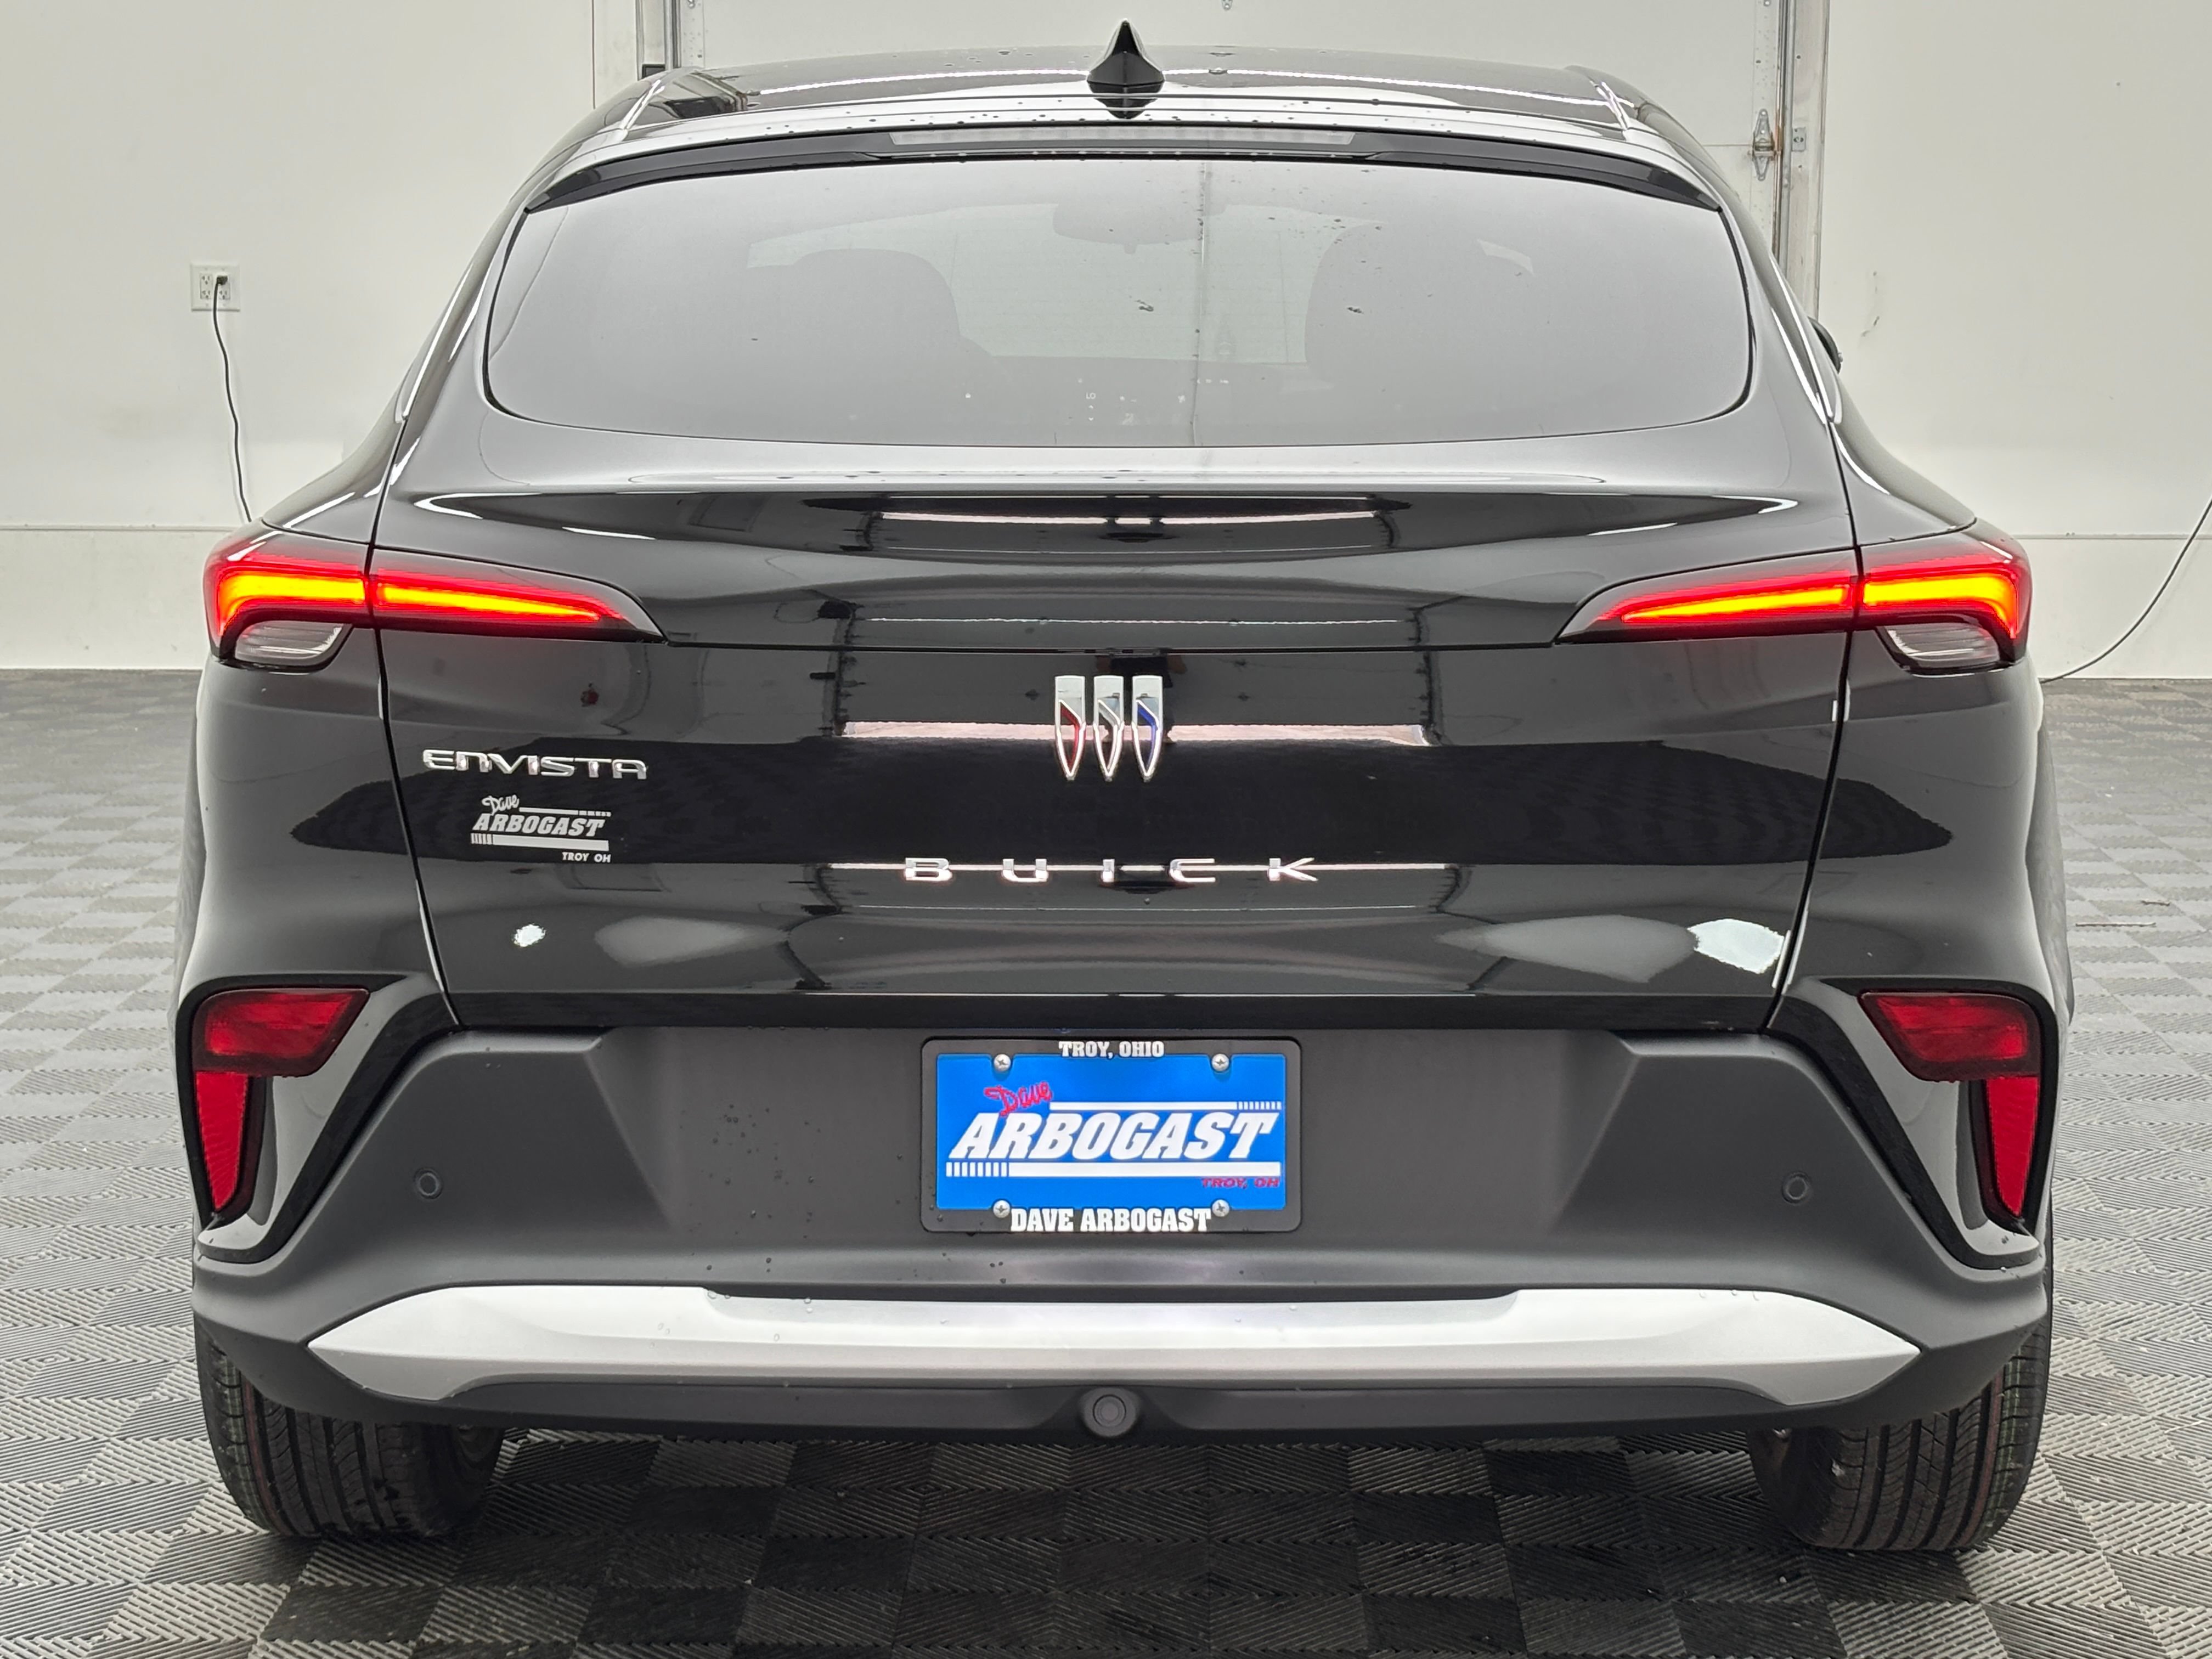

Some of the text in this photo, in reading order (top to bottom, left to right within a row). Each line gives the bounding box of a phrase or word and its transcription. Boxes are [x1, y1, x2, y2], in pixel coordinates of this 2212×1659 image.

[422, 749, 648, 779] ENVISTA
[482, 794, 520, 816] Dave
[472, 813, 606, 837] ARBOGAST
[562, 851, 612, 863] TROY OH
[903, 857, 1318, 882] BUICK
[1058, 1041, 1165, 1059] TROY, OHIO
[984, 1081, 1053, 1116] Dave
[948, 1112, 1279, 1159] ARBOGAST
[1201, 1177, 1280, 1189] TROY, OH
[1011, 1208, 1211, 1232] DAVE ARBOGAST
